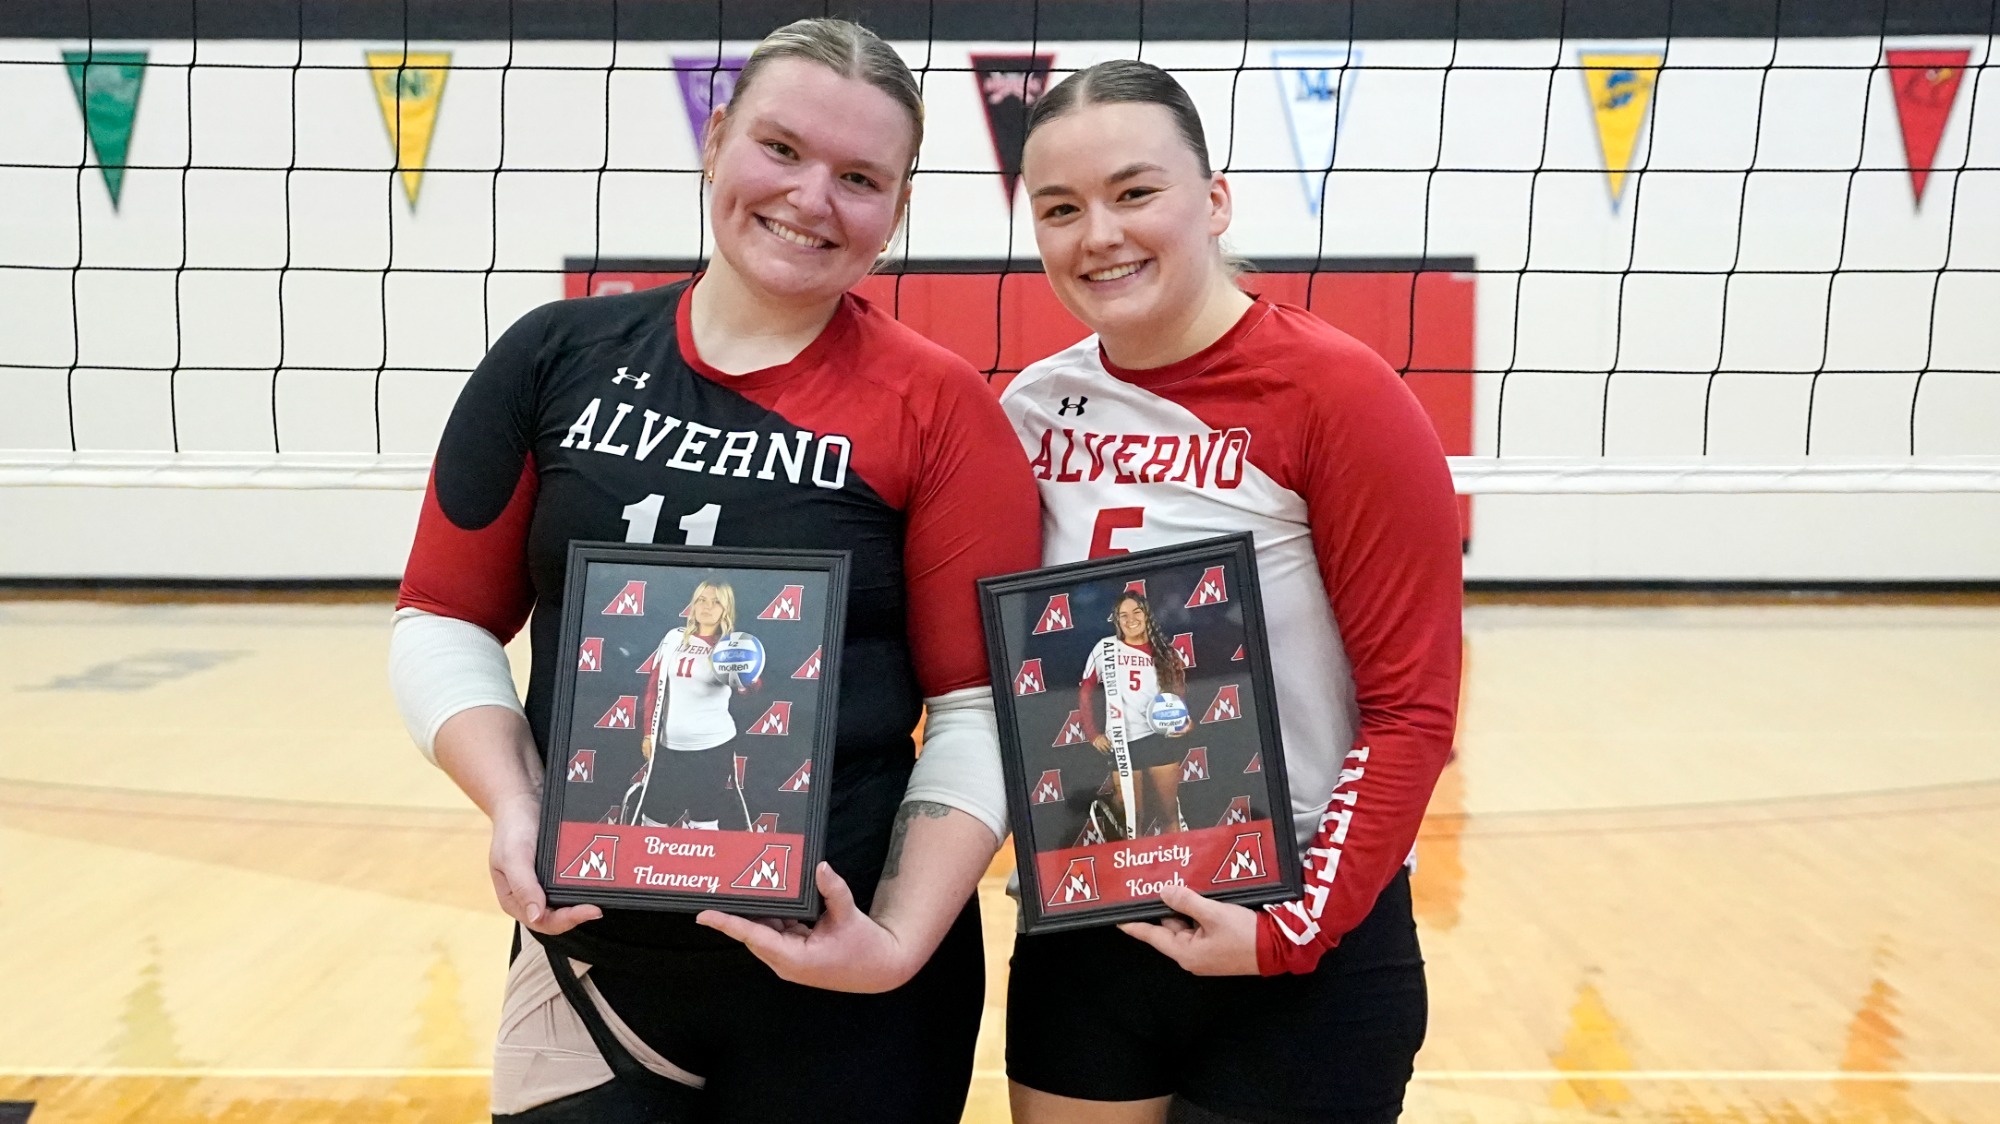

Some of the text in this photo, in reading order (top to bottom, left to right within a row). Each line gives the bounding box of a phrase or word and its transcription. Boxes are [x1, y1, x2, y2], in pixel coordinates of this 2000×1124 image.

[560, 397, 850, 490] ALVERNO
[1031, 428, 1251, 490] ALVERNO
[621, 493, 721, 546] 11
[676, 656, 695, 678] 11
[718, 663, 749, 672] molten
[1103, 641, 1118, 697] ALVERNO
[1117, 655, 1154, 667] LVERN
[1129, 670, 1141, 692] 5
[1112, 726, 1129, 778] INFERNO
[644, 836, 716, 857] Breann
[1113, 844, 1193, 869] Sharisty
[633, 865, 721, 893] Flannery
